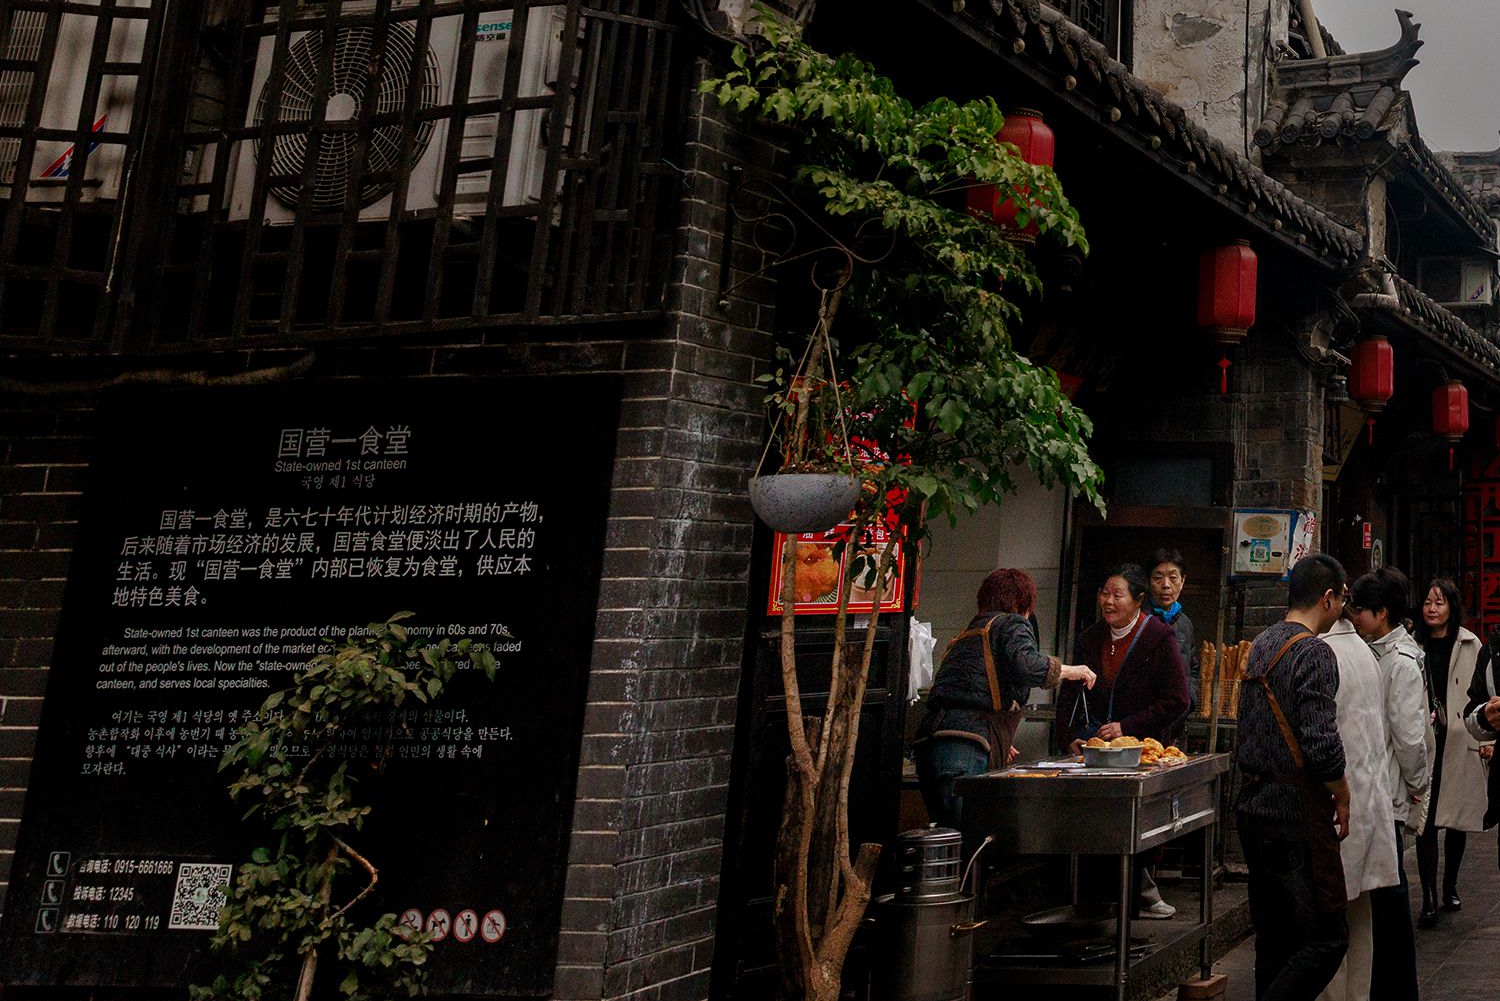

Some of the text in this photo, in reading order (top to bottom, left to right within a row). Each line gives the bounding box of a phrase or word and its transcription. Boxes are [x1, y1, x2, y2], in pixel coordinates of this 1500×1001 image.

[277, 424, 411, 458] 国营一食堂
[274, 459, 407, 472] State-owned 1st canteen
[112, 585, 208, 608] 地特色美食。
[123, 627, 182, 639] State-owned
[186, 627, 199, 637] 1st
[201, 627, 239, 638] canteen
[241, 628, 260, 638] was
[263, 626, 278, 637] the
[280, 626, 316, 639] product
[318, 626, 330, 637] of
[331, 625, 346, 636] the
[436, 624, 446, 635] in
[448, 624, 466, 635] 60s
[468, 624, 488, 635] and
[101, 644, 149, 657] afterward,
[151, 644, 170, 655] with
[172, 643, 187, 655] the
[189, 643, 250, 657] development
[253, 643, 264, 654] of
[264, 643, 279, 654] the
[282, 642, 315, 654] market
[99, 660, 115, 672] out
[116, 660, 127, 672] of
[128, 660, 143, 672] the
[145, 660, 185, 674] people's
[186, 660, 211, 672] lives.
[214, 660, 235, 671] Now
[238, 659, 252, 671] the
[96, 676, 270, 691] canteen, and serves local specialties.
[147, 709, 168, 723] 국영
[125, 915, 140, 929] 120
[144, 915, 160, 930] 119
